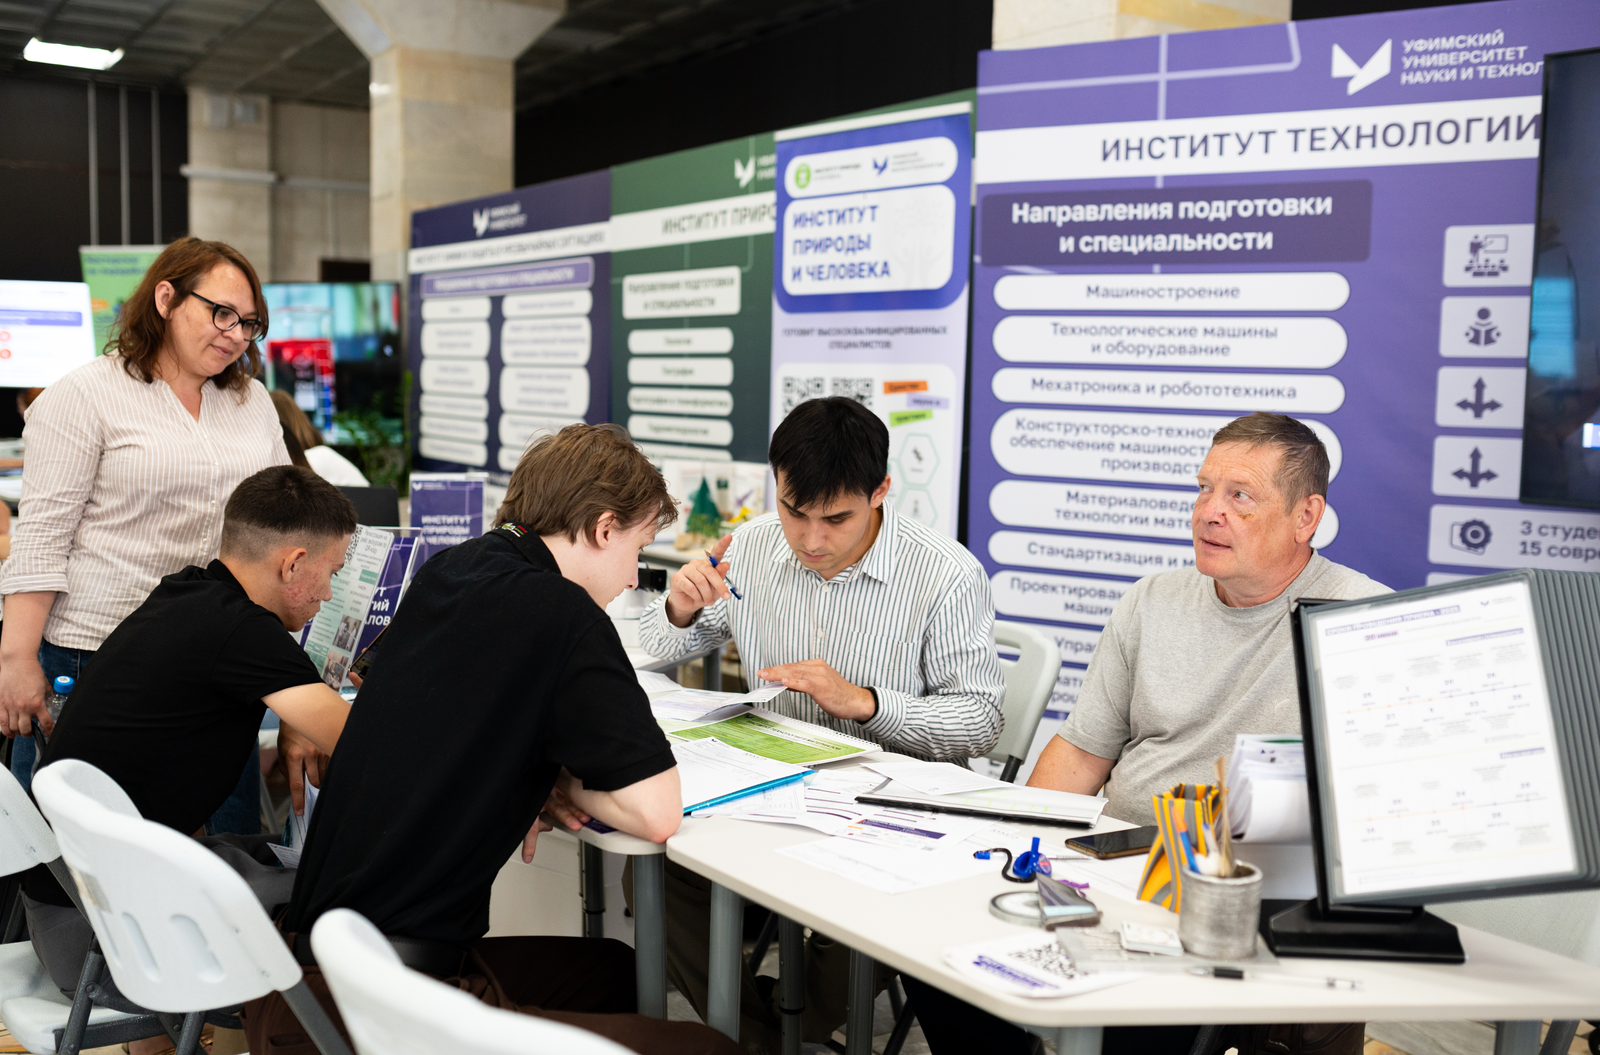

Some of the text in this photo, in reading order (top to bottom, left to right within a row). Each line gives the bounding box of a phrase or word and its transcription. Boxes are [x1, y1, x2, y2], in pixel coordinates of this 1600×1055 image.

[1402, 29, 1504, 54] УФИМСКИЙ
[1401, 46, 1528, 69] УНИВЕРСИТЕТ
[1400, 61, 1544, 85] НАУКИ И ТЕХНОЛ
[1101, 113, 1541, 162] ИНСТИТУТ ТЕХНОЛОГИИ
[663, 208, 728, 235] ИНСТИТУТ
[793, 206, 879, 229] ИНСТИТУТ
[1012, 196, 1333, 225] Направления подготовки
[793, 234, 871, 256] ПРИРОДЫ
[1059, 228, 1273, 256] и специальности
[792, 261, 890, 282] И ЧЕЛОВЕКА
[1086, 282, 1241, 303] Машиностроение
[1051, 321, 1278, 341] Технологические машины
[1091, 340, 1231, 359] и оборудование
[1031, 376, 1297, 401] Мехатроника и робототехника
[1015, 418, 1214, 440] Конструкторско-технол
[1010, 434, 1208, 457] обеспечение машиност
[1101, 456, 1199, 476] производст
[1066, 489, 1195, 513] Материаловеде
[421, 514, 472, 525] ИНСТИТУТ
[1055, 505, 1192, 530] технологии мате
[422, 526, 470, 536] ПРИРОДЫ
[1521, 520, 1600, 542] 3 студе
[1027, 541, 1196, 569] Стандартизация и м
[1520, 541, 1541, 556] 15
[375, 586, 387, 598] УТ
[1010, 576, 1124, 601] Проектирован
[371, 598, 390, 612] ИЙ
[1064, 601, 1113, 617] машин
[1054, 635, 1096, 655] Упра
